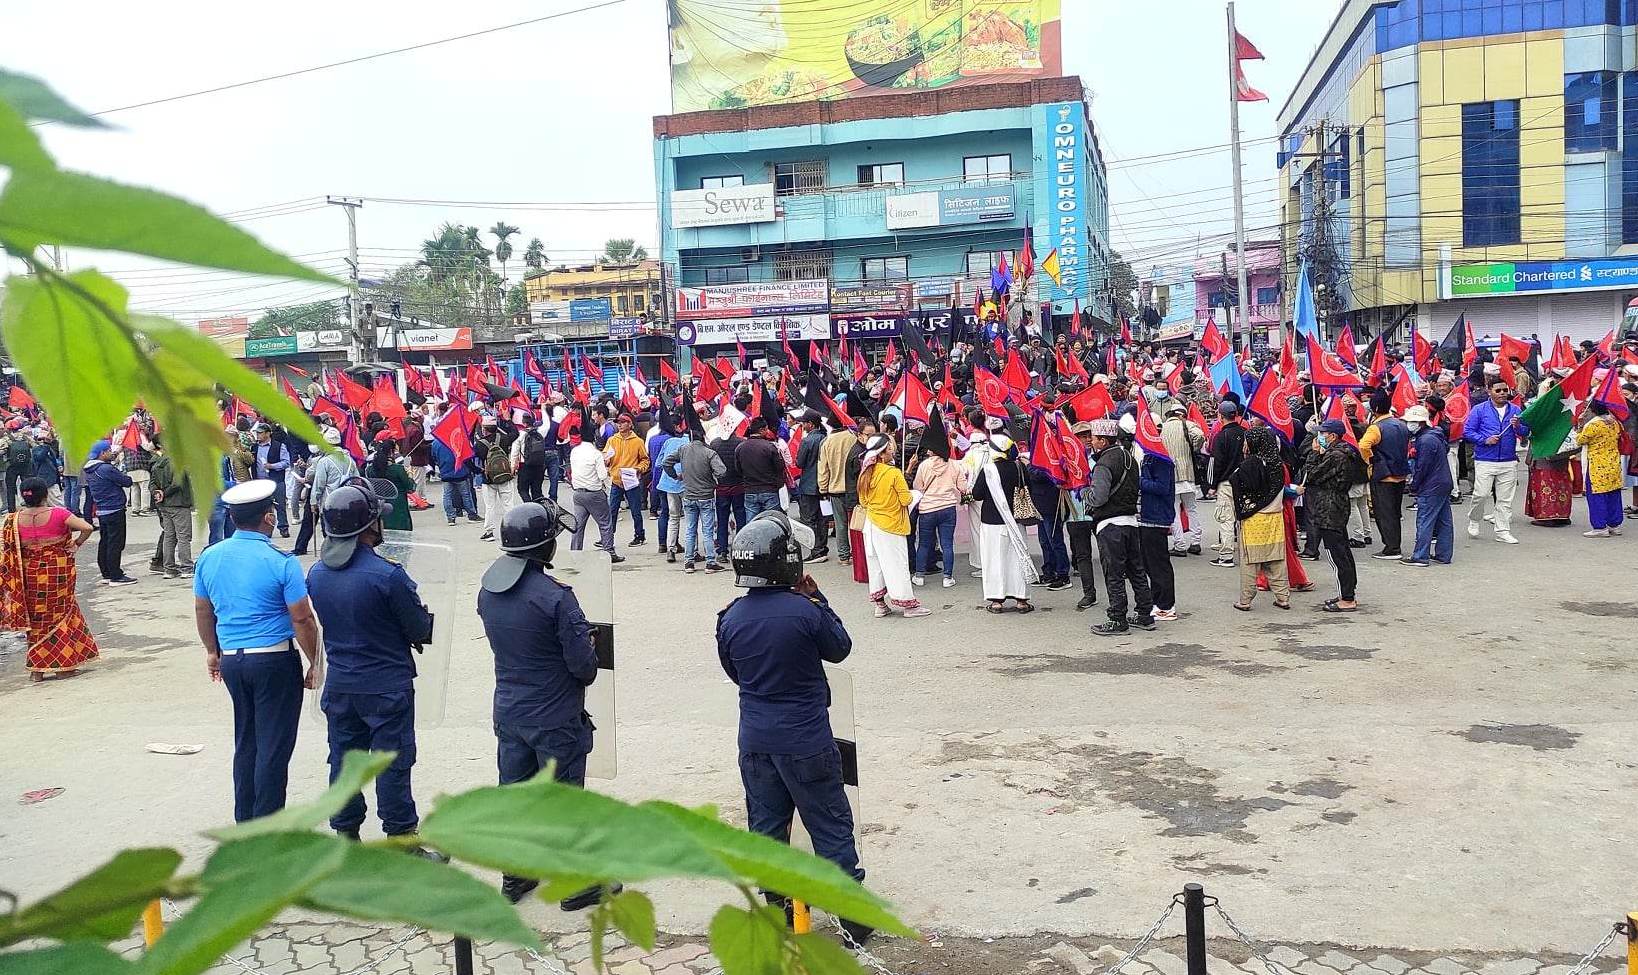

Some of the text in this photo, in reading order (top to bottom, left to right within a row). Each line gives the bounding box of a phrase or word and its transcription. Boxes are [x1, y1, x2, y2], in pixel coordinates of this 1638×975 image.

[704, 191, 765, 215] Sewa
[1059, 216, 1080, 296] PHARMACY
[1452, 268, 1576, 286] Standard Chartered
[706, 281, 825, 295] MANJUSHREE FINANCE LIMITED
[873, 288, 897, 296] Courier
[850, 316, 896, 332] ओम
[411, 333, 439, 343] vianet
[731, 550, 755, 560] POLICE
